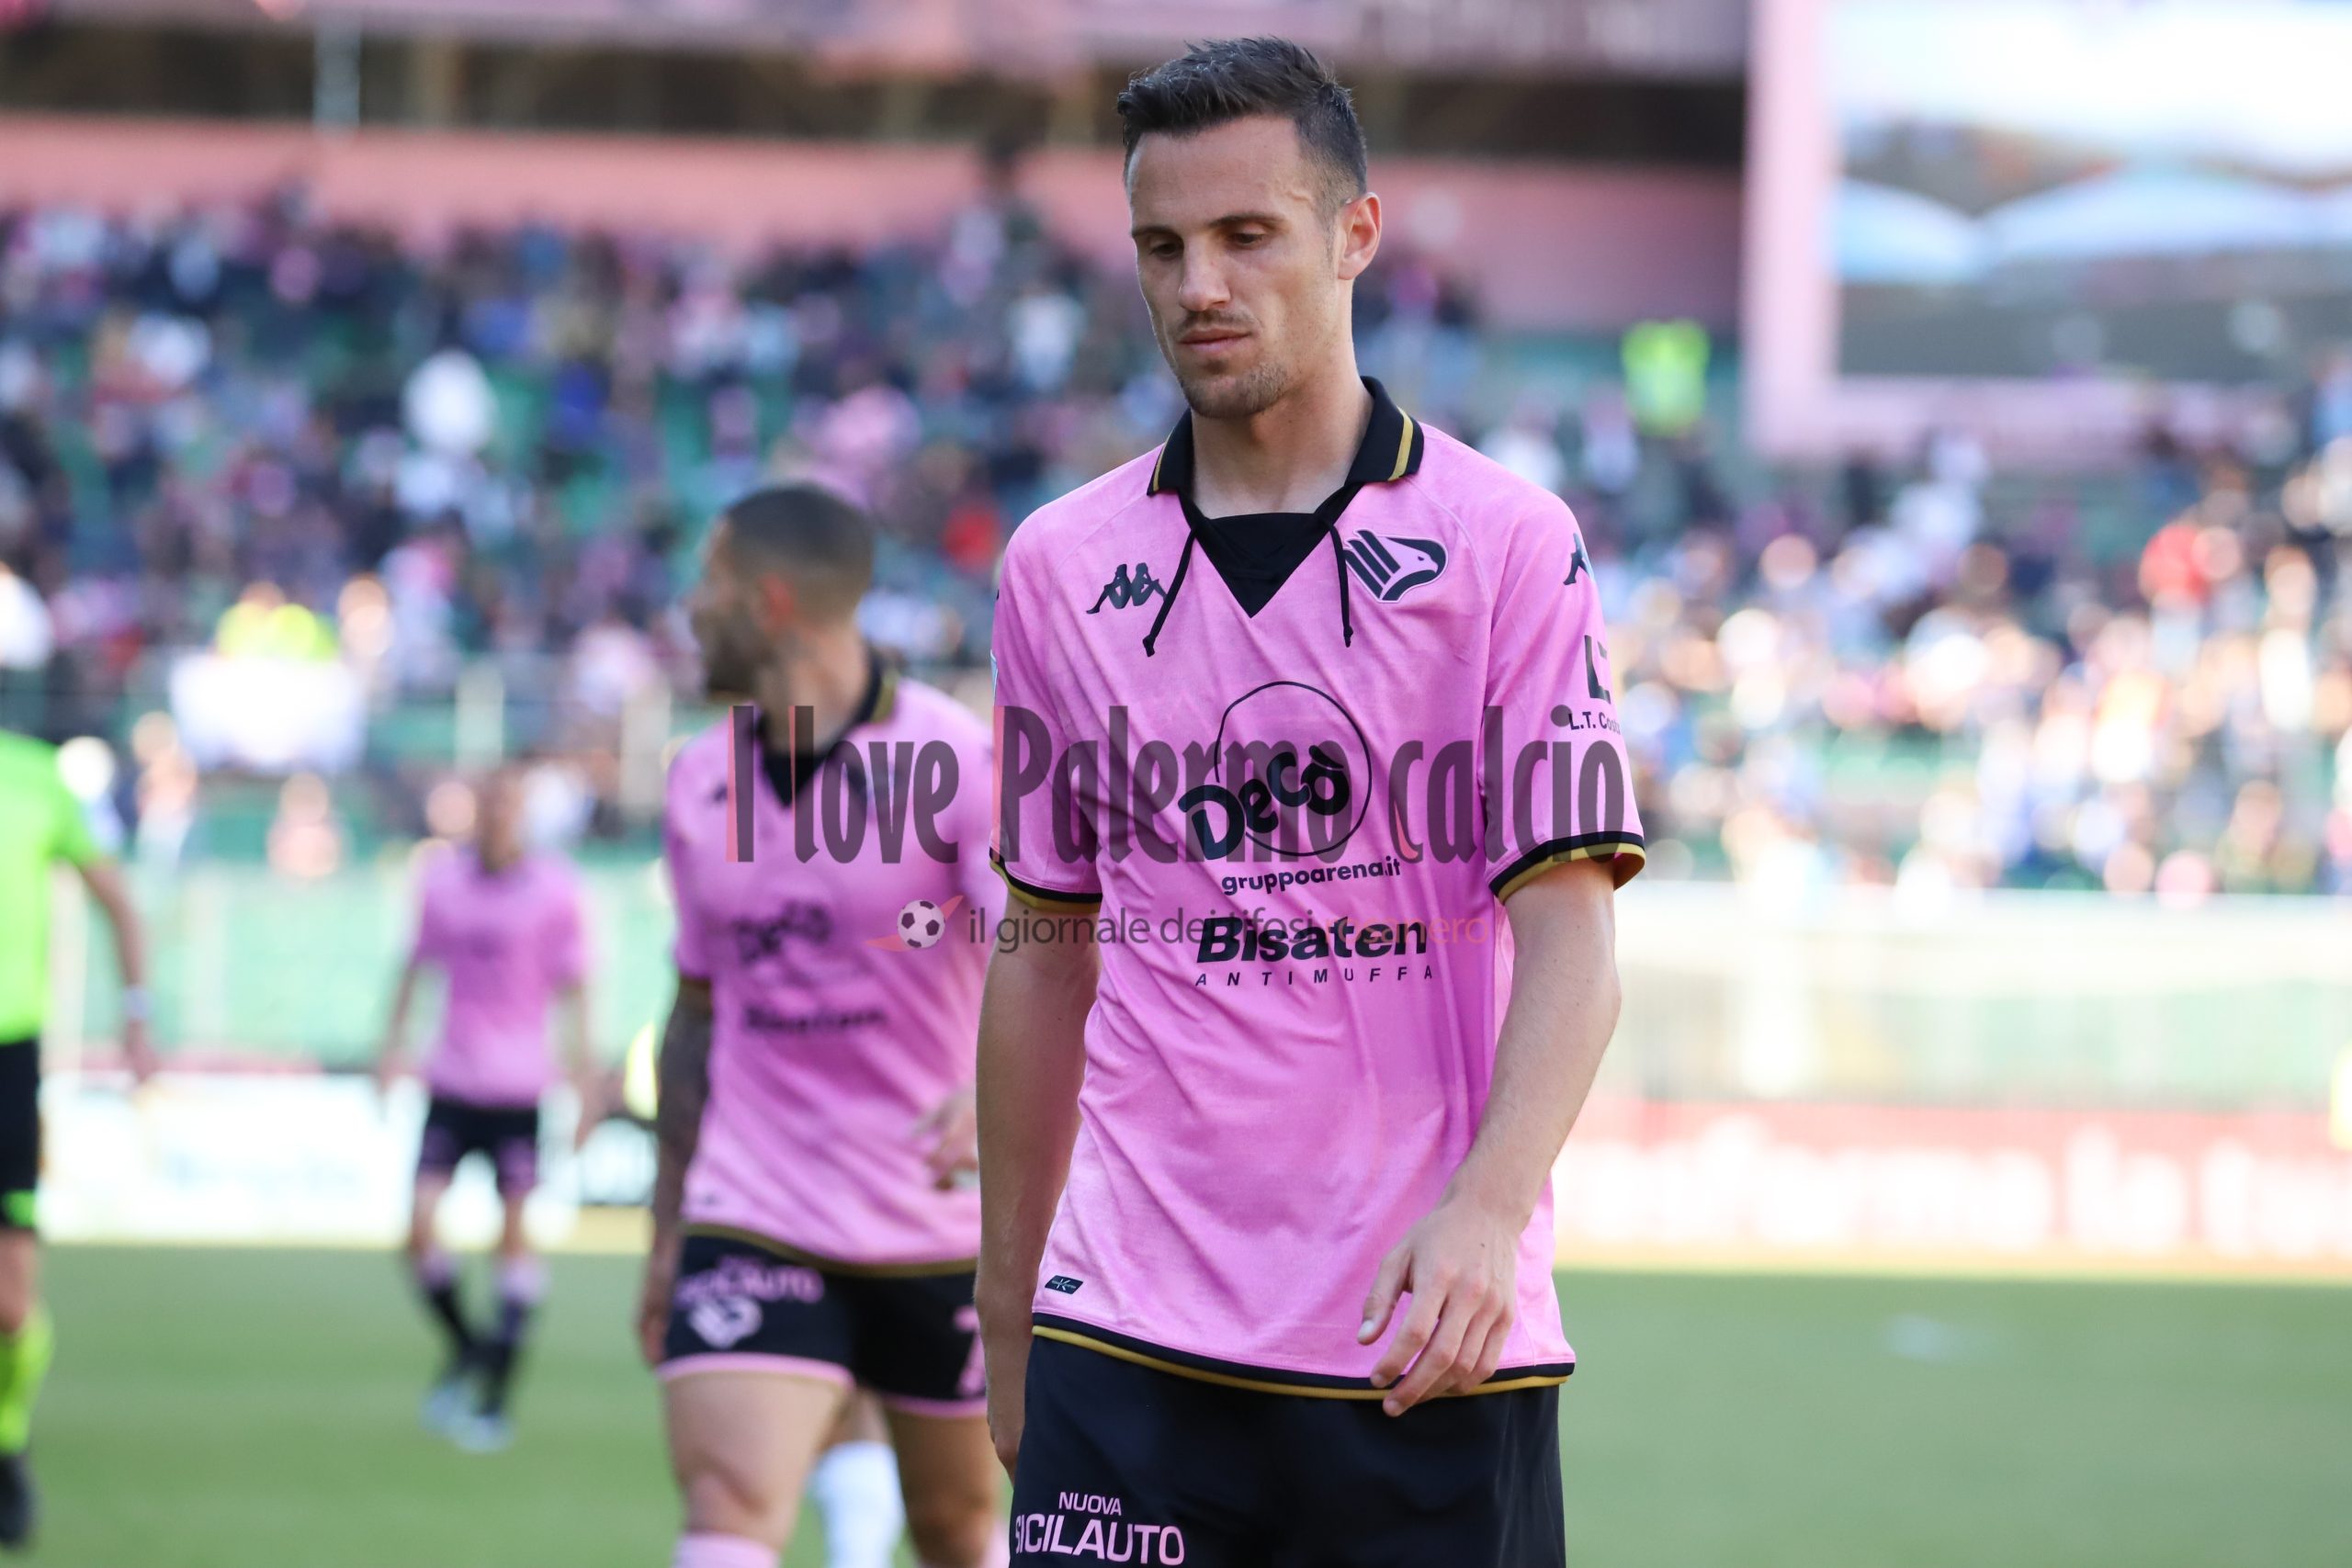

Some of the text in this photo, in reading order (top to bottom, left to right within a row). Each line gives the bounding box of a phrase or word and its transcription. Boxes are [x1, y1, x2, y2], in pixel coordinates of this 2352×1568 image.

[1178, 745, 1350, 860] Decò
[1221, 856, 1401, 895] gruppoarena.it
[1196, 916, 1428, 963] Bisaten
[1195, 965, 1432, 987] ANTIMUFFA
[1058, 1491, 1123, 1517] NUOVA
[1014, 1513, 1186, 1566] SICILAUTO
